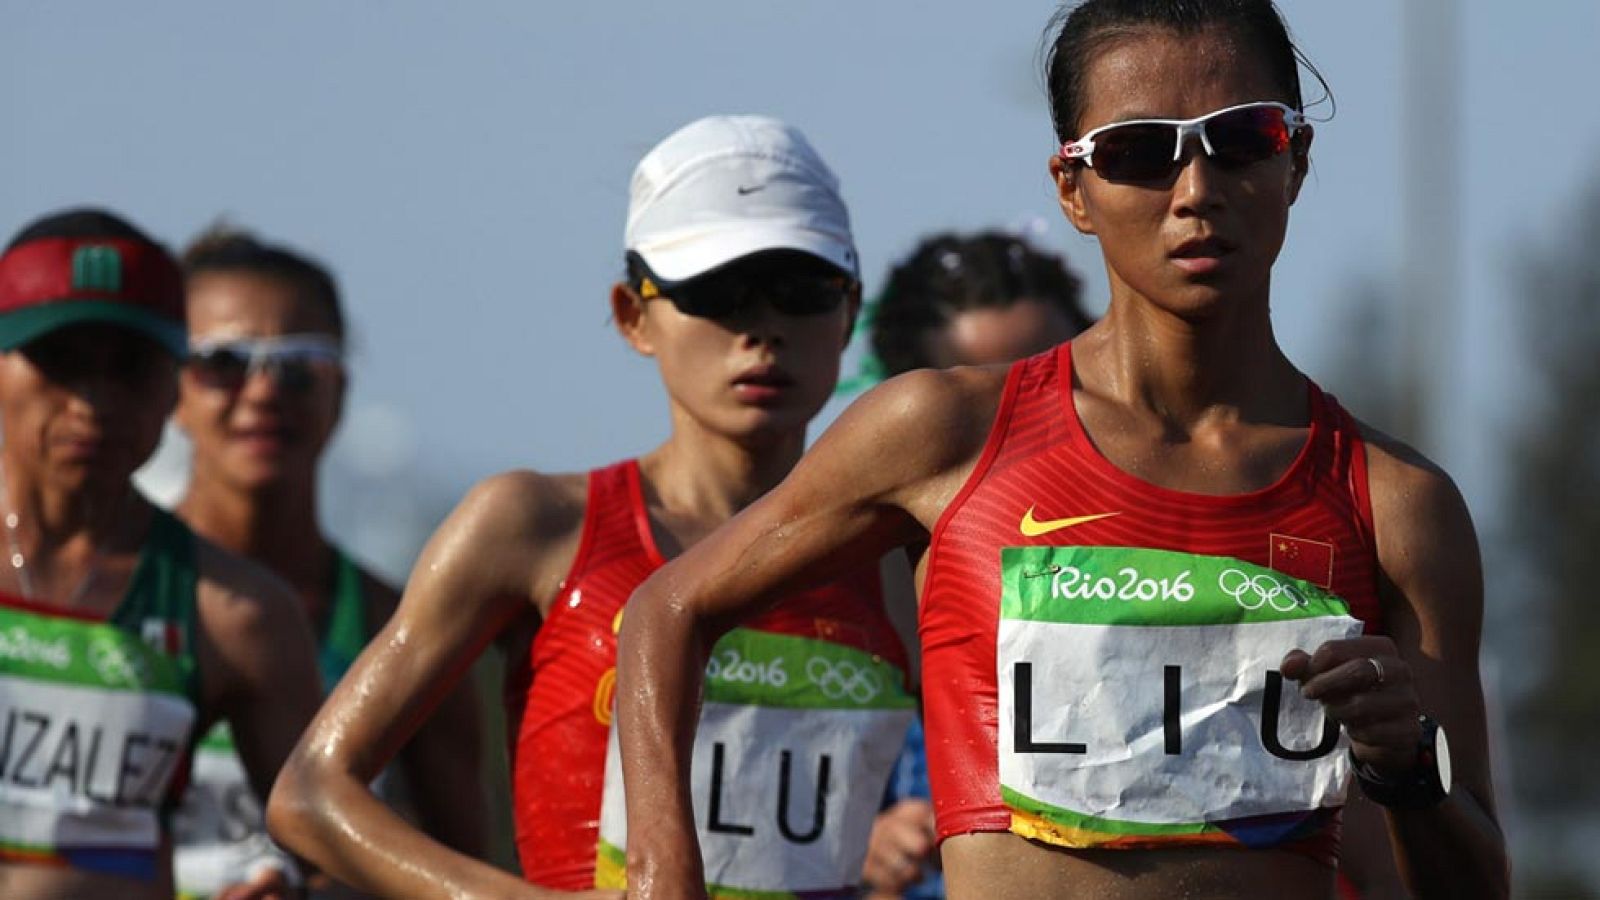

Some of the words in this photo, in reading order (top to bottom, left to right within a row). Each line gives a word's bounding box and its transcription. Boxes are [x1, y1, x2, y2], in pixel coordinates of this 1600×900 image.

[1051, 566, 1195, 602] Rio2016
[1013, 662, 1341, 761] LIU
[707, 742, 831, 844] LU
